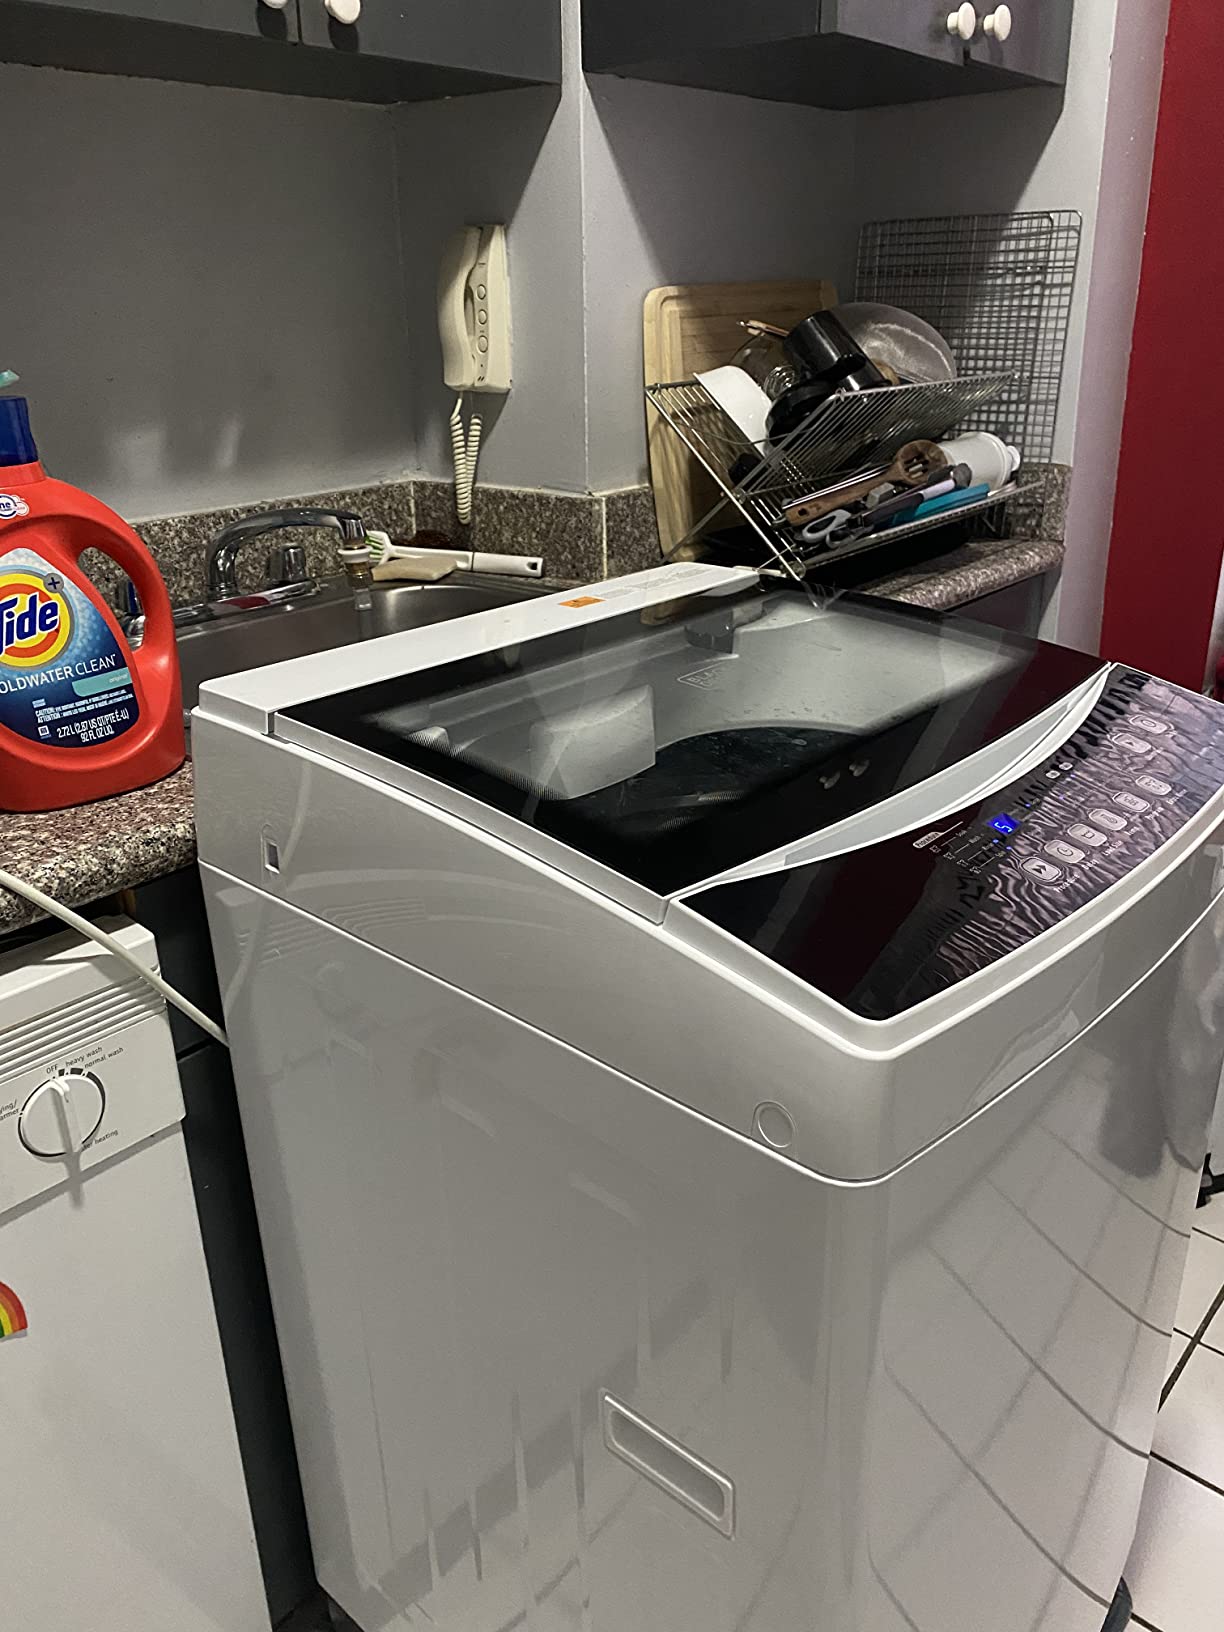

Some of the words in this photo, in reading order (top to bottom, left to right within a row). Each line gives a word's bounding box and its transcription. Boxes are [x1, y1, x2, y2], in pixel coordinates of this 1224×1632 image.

[0, 592, 59, 656] Tide
[65, 1055, 85, 1067] heavy
[86, 1046, 103, 1057] wash
[84, 1055, 107, 1069] normal
[107, 1047, 124, 1058] wash
[46, 1064, 59, 1075] OFF
[94, 1129, 119, 1145] heating
